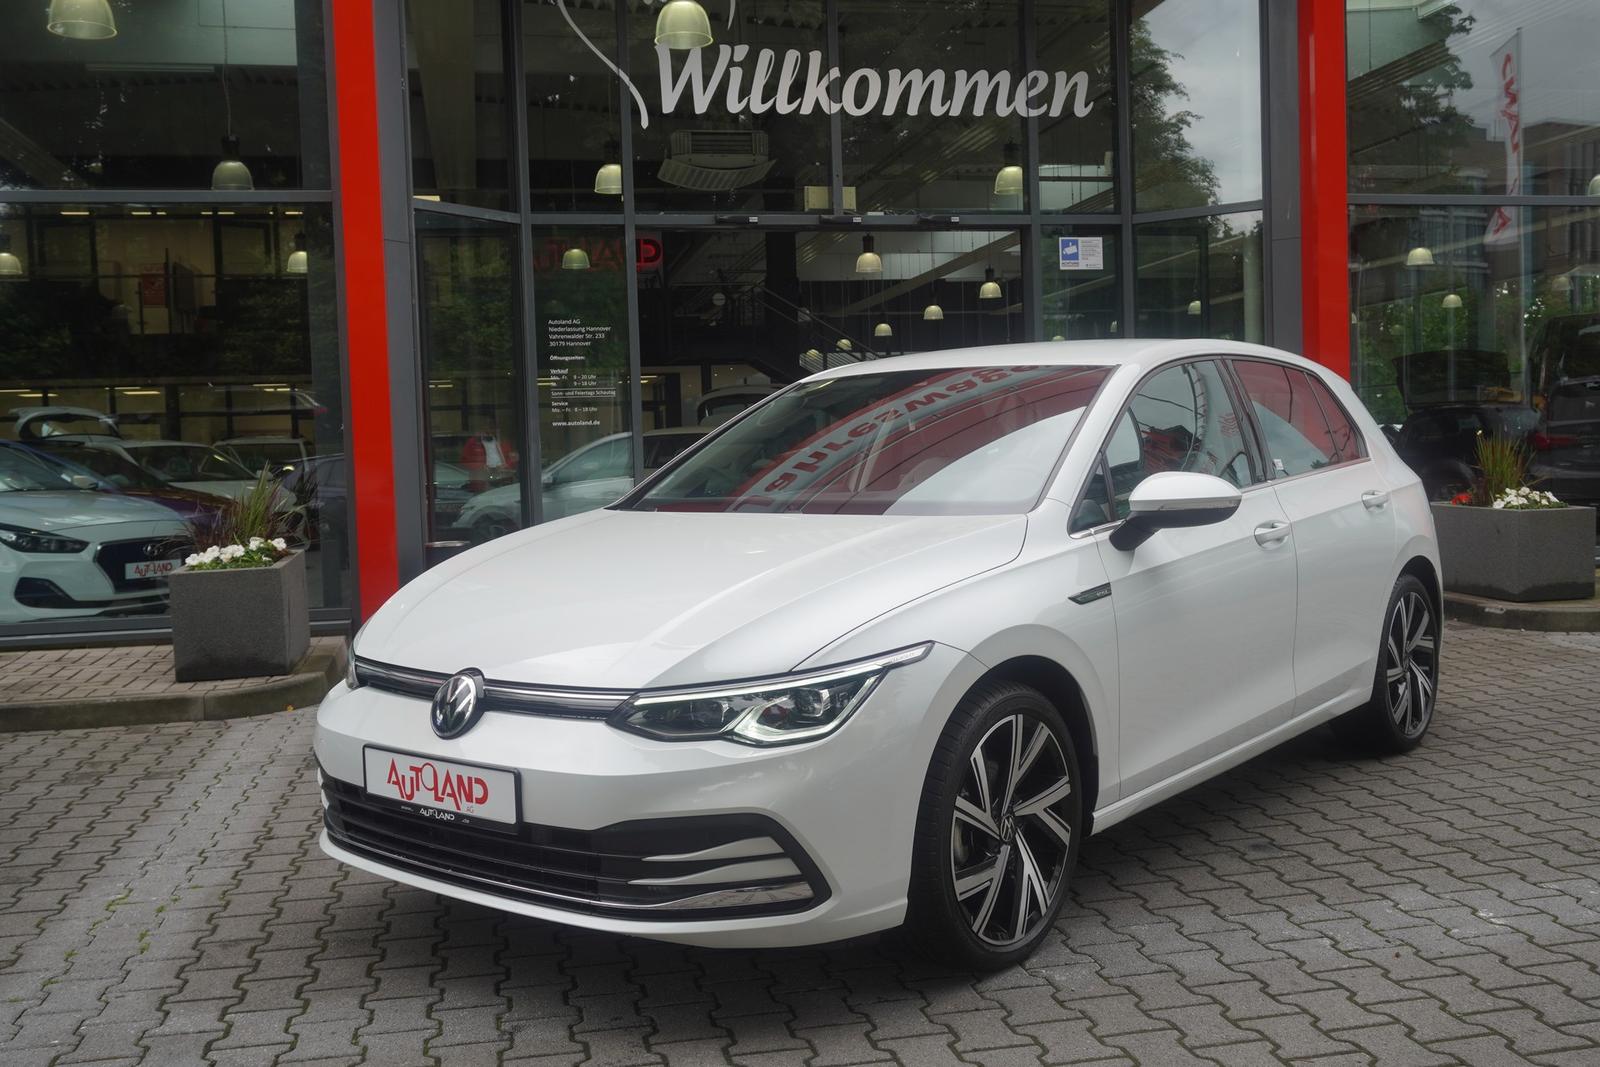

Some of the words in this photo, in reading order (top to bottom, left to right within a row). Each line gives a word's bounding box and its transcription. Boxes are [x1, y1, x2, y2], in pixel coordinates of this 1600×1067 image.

[654, 43, 1095, 118] Willkommen
[132, 562, 173, 577] AUTOLAND
[386, 757, 489, 811] AUTOLAND
[419, 807, 455, 821] AUTOLAND
